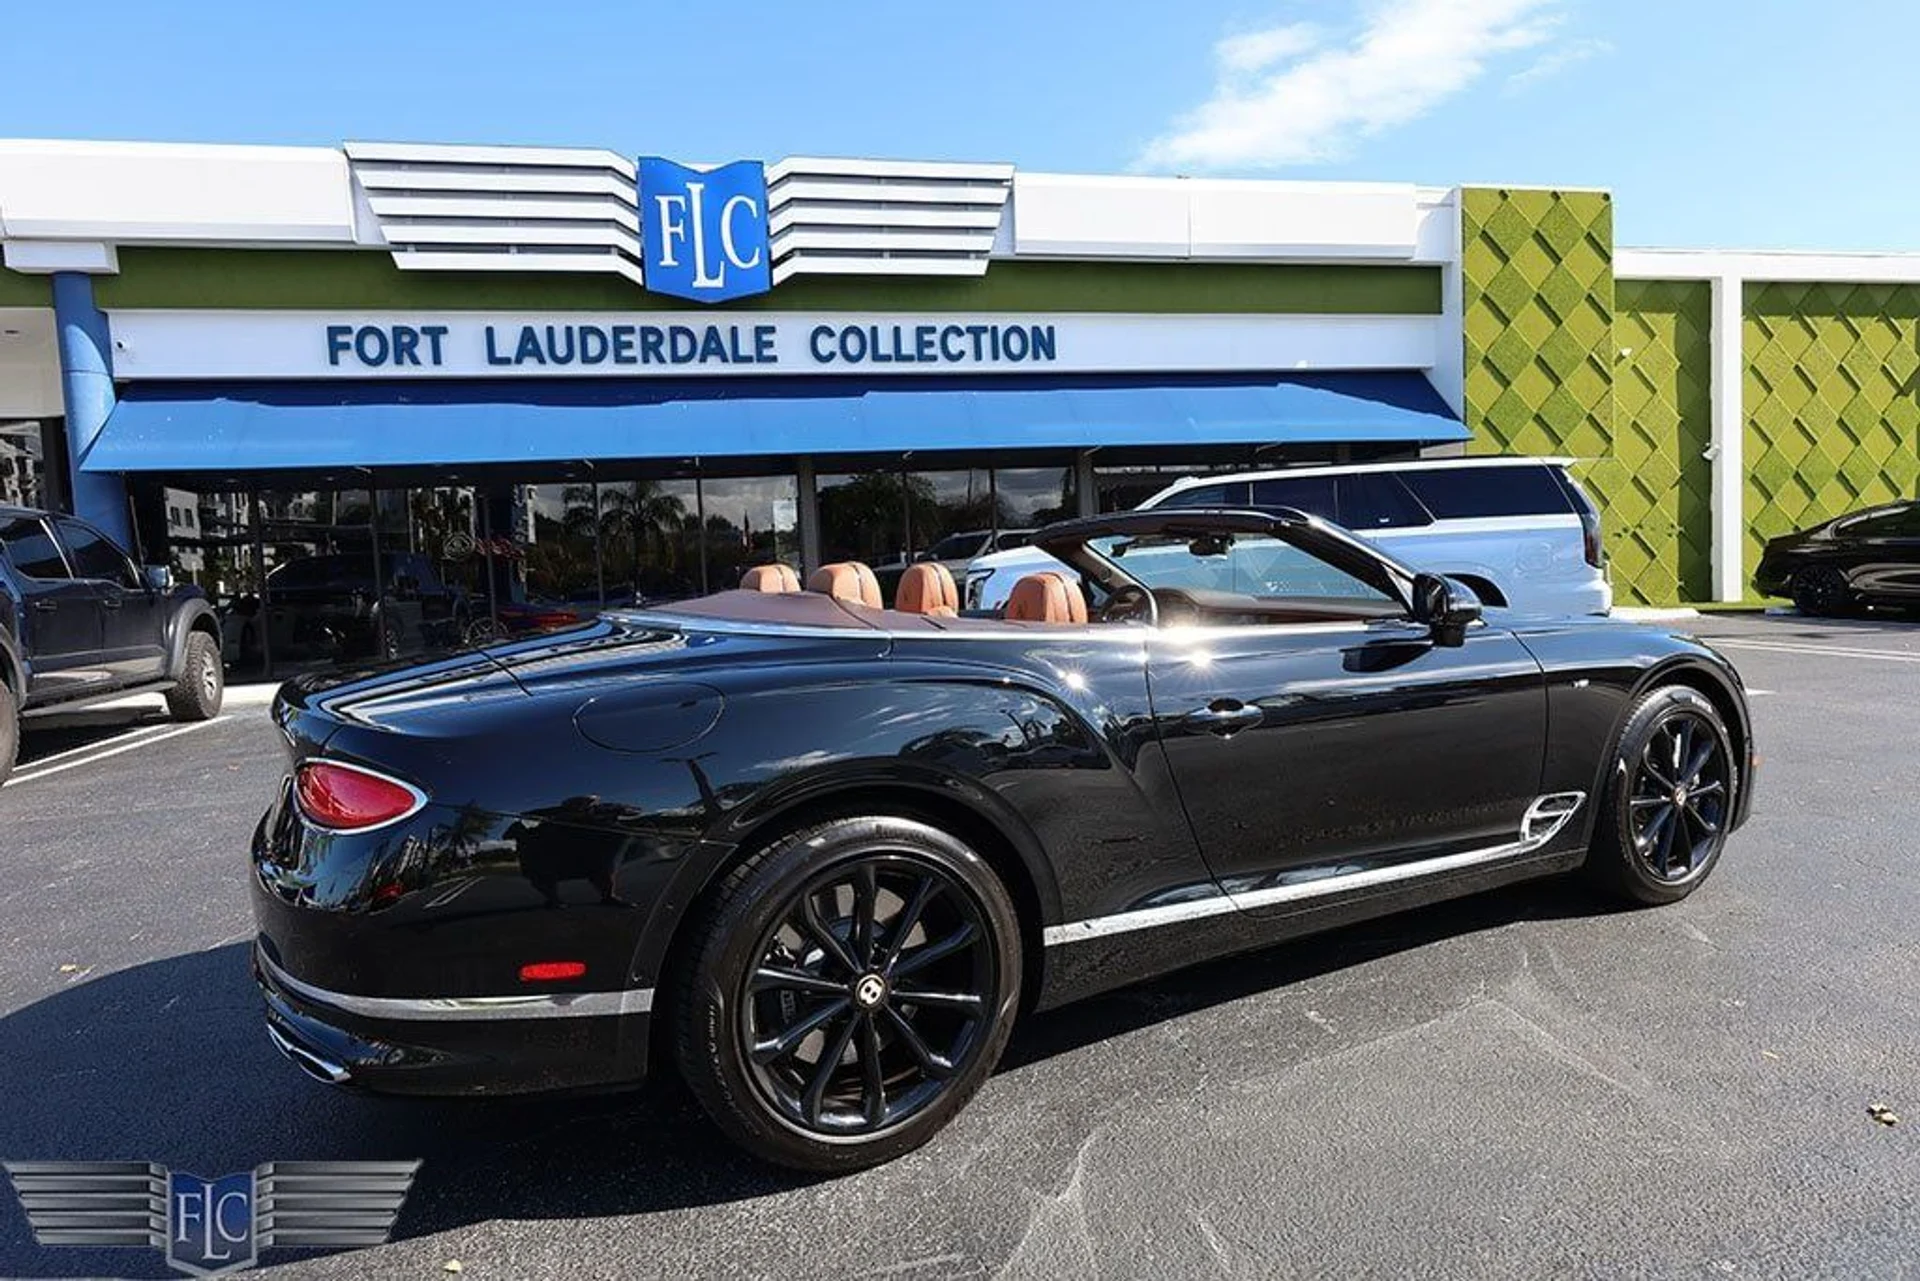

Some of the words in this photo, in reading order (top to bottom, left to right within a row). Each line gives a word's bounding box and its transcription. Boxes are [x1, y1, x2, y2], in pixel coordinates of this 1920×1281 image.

[654, 181, 761, 289] FLC
[326, 325, 449, 367] FORT
[485, 325, 778, 366] LAUDERDALE
[809, 324, 1057, 364] COLLECTION
